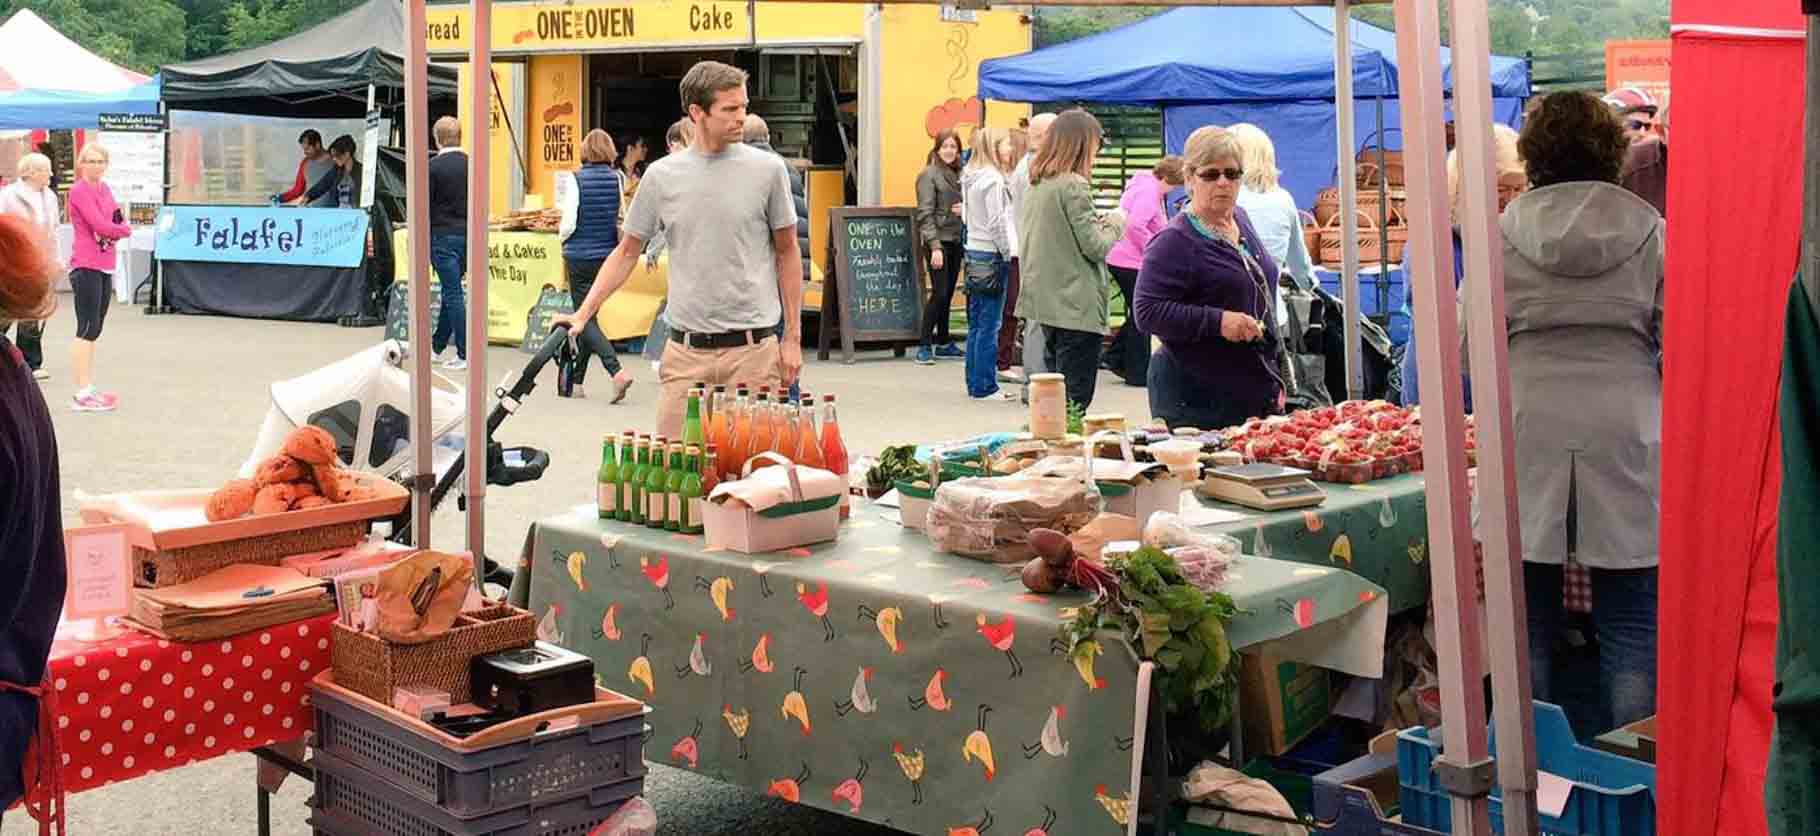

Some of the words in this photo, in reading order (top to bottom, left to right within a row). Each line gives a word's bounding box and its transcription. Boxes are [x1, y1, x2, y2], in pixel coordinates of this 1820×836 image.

[537, 10, 573, 40] ONE
[585, 7, 634, 38] OVEN
[689, 3, 733, 32] Cake
[425, 15, 460, 40] read
[543, 124, 566, 143] ONE
[543, 144, 574, 161] OVEN
[194, 217, 304, 252] Falafel
[847, 222, 873, 236] ONE
[502, 244, 511, 259] &
[513, 243, 547, 260] Cakes
[850, 238, 882, 250] OVEN
[509, 265, 528, 286] Day
[859, 296, 902, 314] HERE
